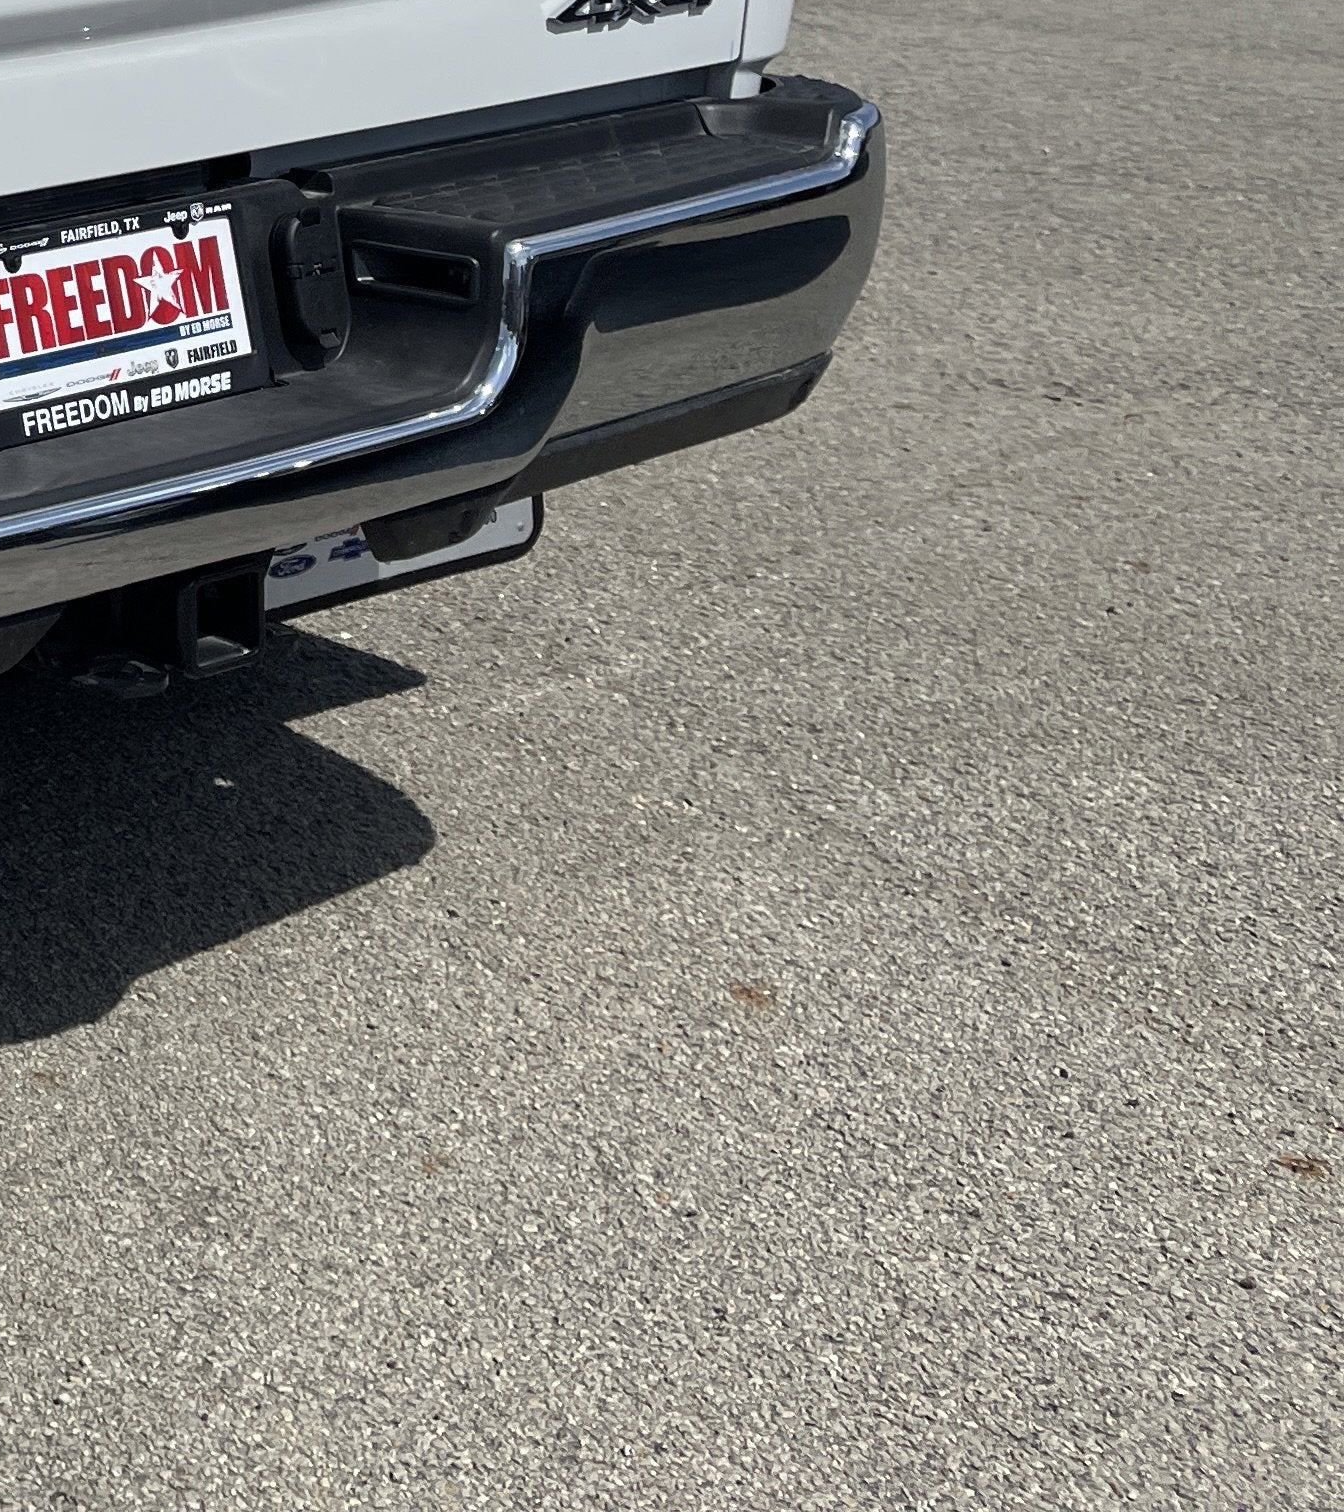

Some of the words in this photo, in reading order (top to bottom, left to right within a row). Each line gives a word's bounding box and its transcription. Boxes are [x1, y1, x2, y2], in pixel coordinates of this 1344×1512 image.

[60, 220, 123, 244] FAIRFIELD,
[123, 216, 140, 231] TX
[163, 210, 188, 223] Jeep
[192, 322, 203, 333] ED
[203, 315, 231, 332] MORSE
[127, 359, 159, 377] Jeep
[187, 339, 238, 364] FAIRFIELD
[22, 390, 130, 437] FREEDOM
[150, 385, 173, 408] ED
[174, 370, 232, 403] MORSE
